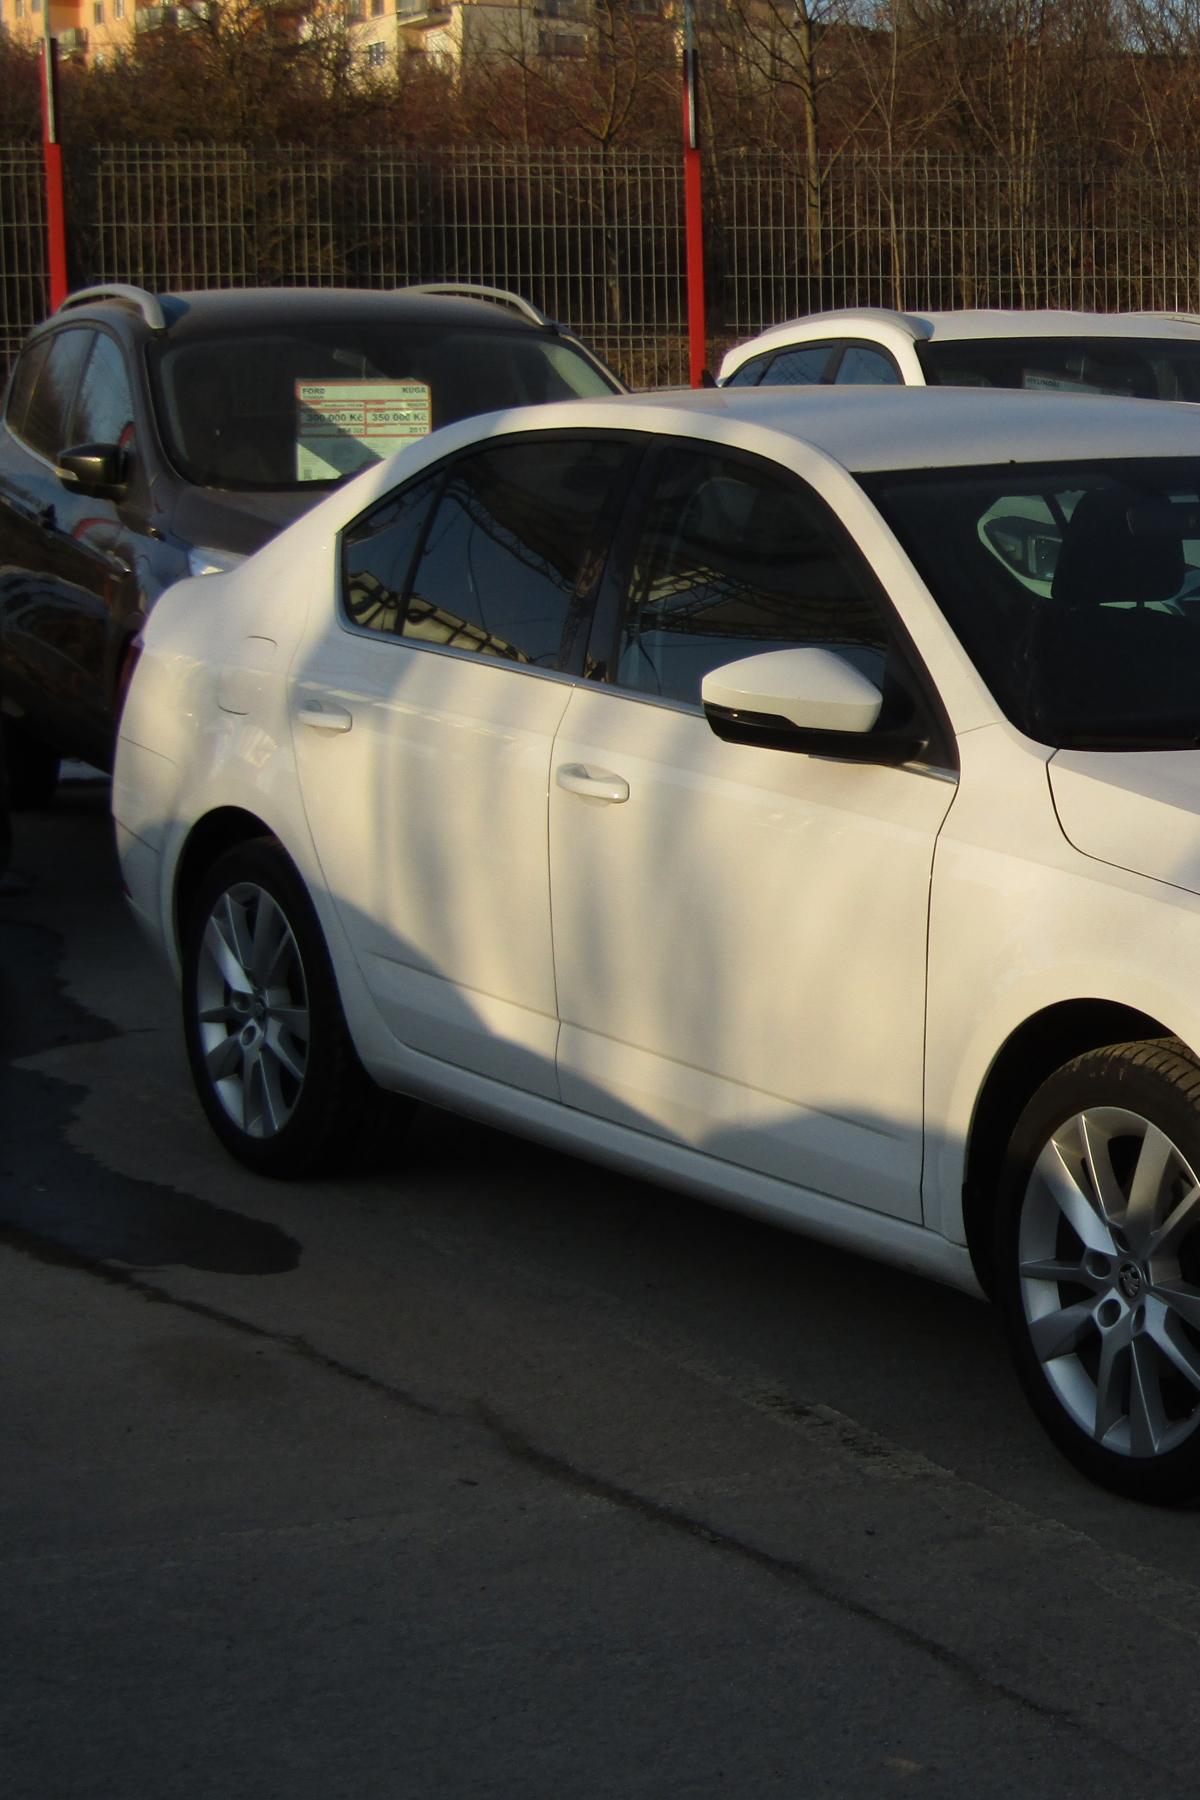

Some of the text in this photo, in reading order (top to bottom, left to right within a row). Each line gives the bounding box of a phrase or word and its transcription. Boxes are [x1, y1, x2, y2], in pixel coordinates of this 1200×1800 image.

[402, 386, 426, 394] KUGA
[372, 413, 390, 422] 350
[393, 413, 411, 422] 000
